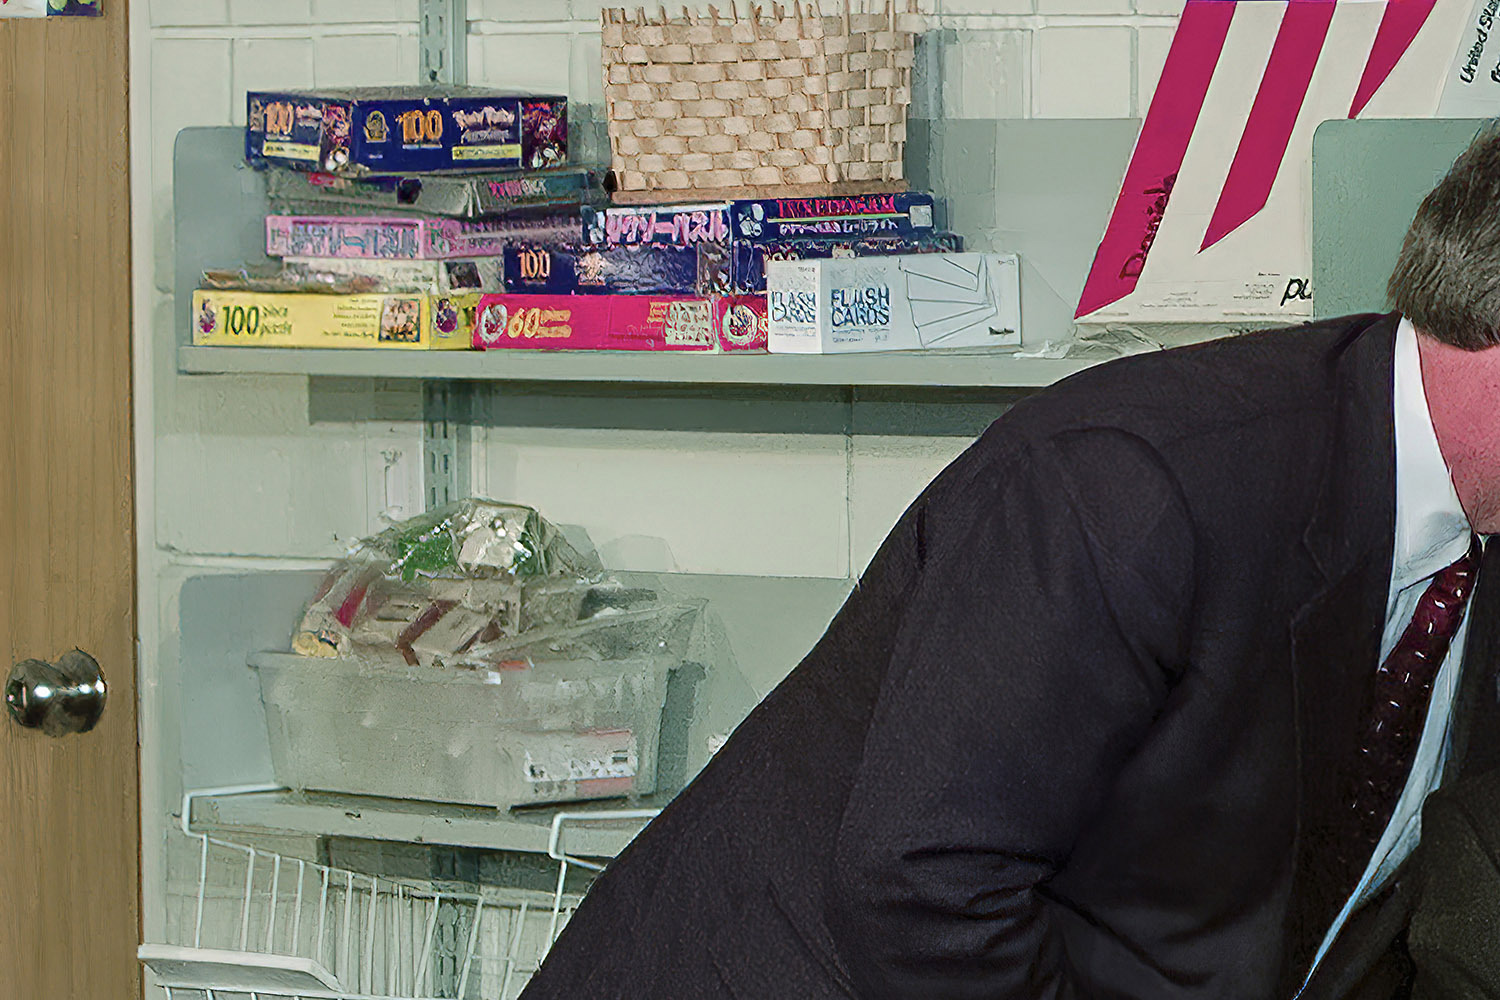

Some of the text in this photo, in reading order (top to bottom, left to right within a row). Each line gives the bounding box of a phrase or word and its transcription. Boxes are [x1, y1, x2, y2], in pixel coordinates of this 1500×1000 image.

[395, 109, 444, 145] 100
[517, 248, 551, 280] 100
[222, 305, 260, 337] 100
[830, 307, 891, 328] CARDS
